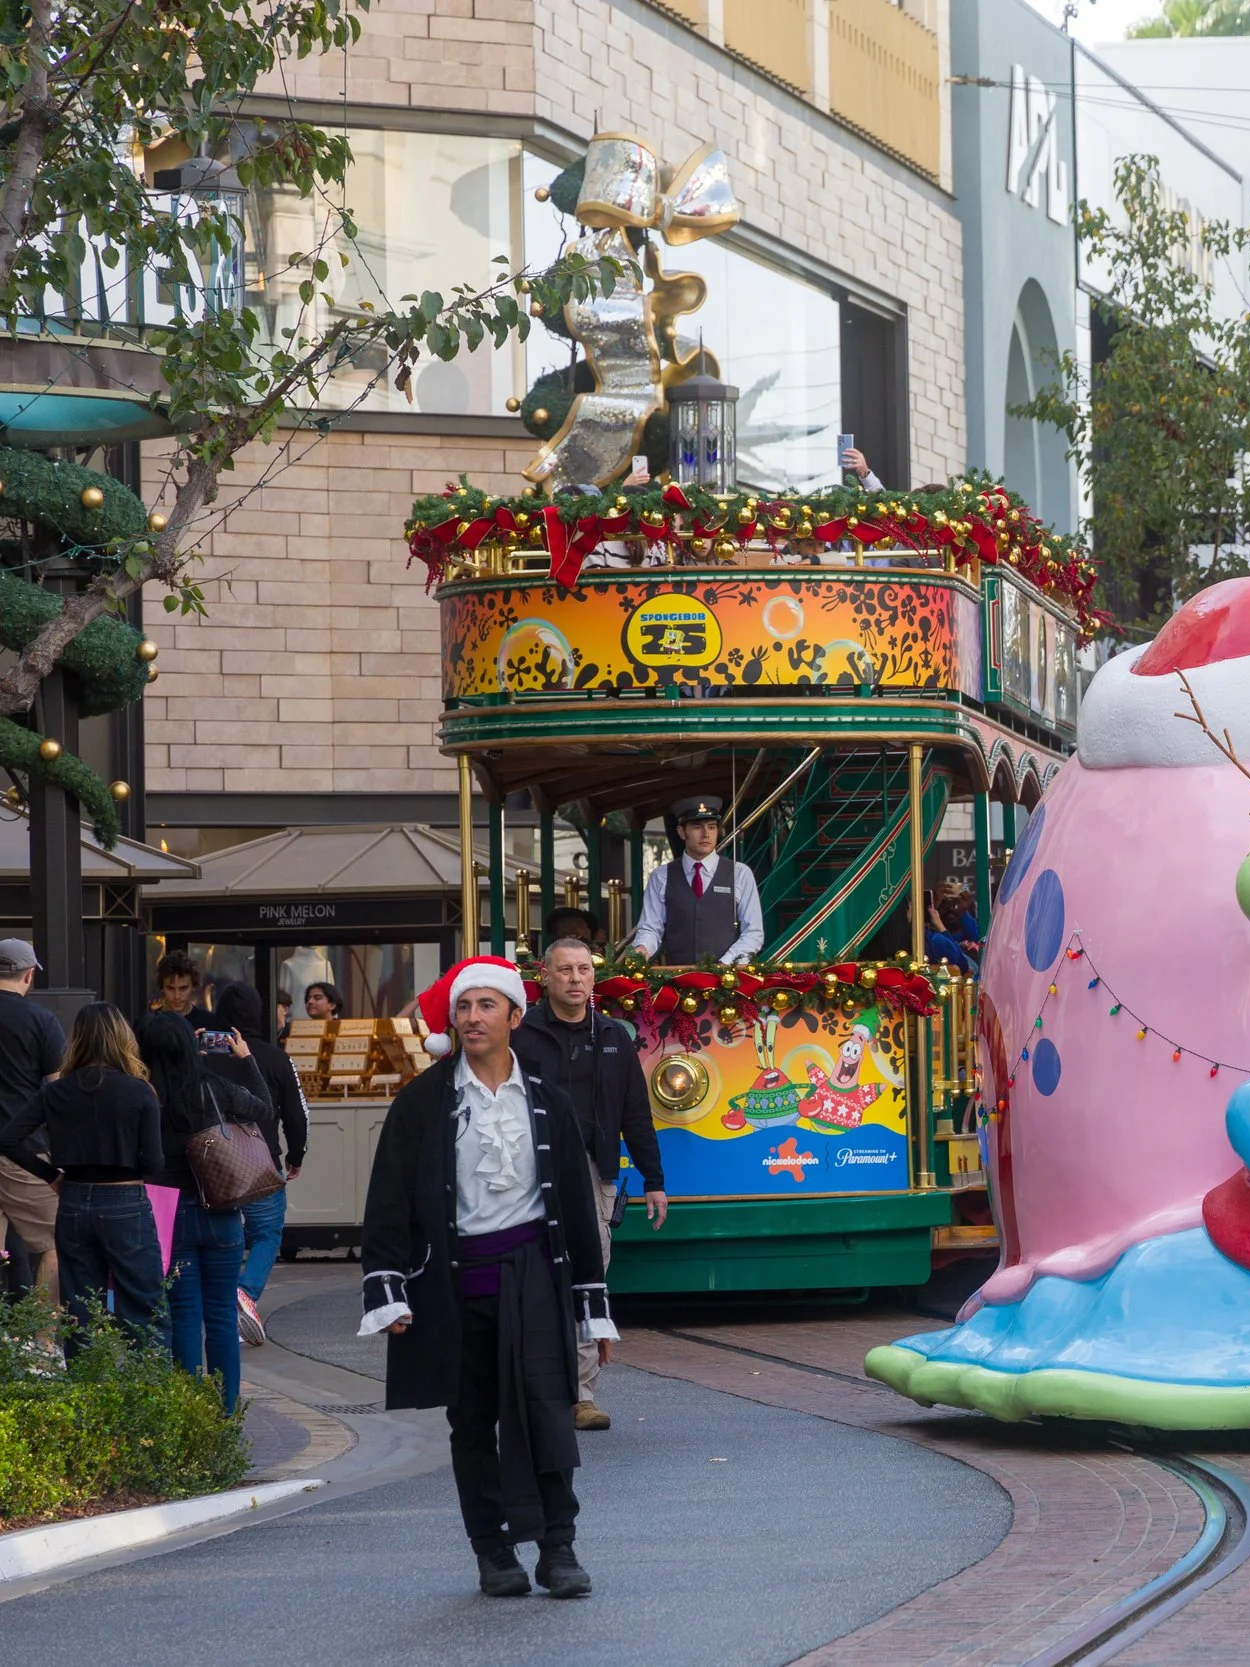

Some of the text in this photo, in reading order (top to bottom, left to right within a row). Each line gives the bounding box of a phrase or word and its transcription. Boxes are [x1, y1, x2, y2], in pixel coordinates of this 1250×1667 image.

[640, 612, 706, 622] SPONGEBOB
[640, 623, 707, 655] 25
[259, 904, 336, 918] PINK MELON
[277, 918, 306, 926] JEWELRY
[762, 1155, 819, 1166] nickelodeon
[834, 1148, 897, 1168] Paramount+
